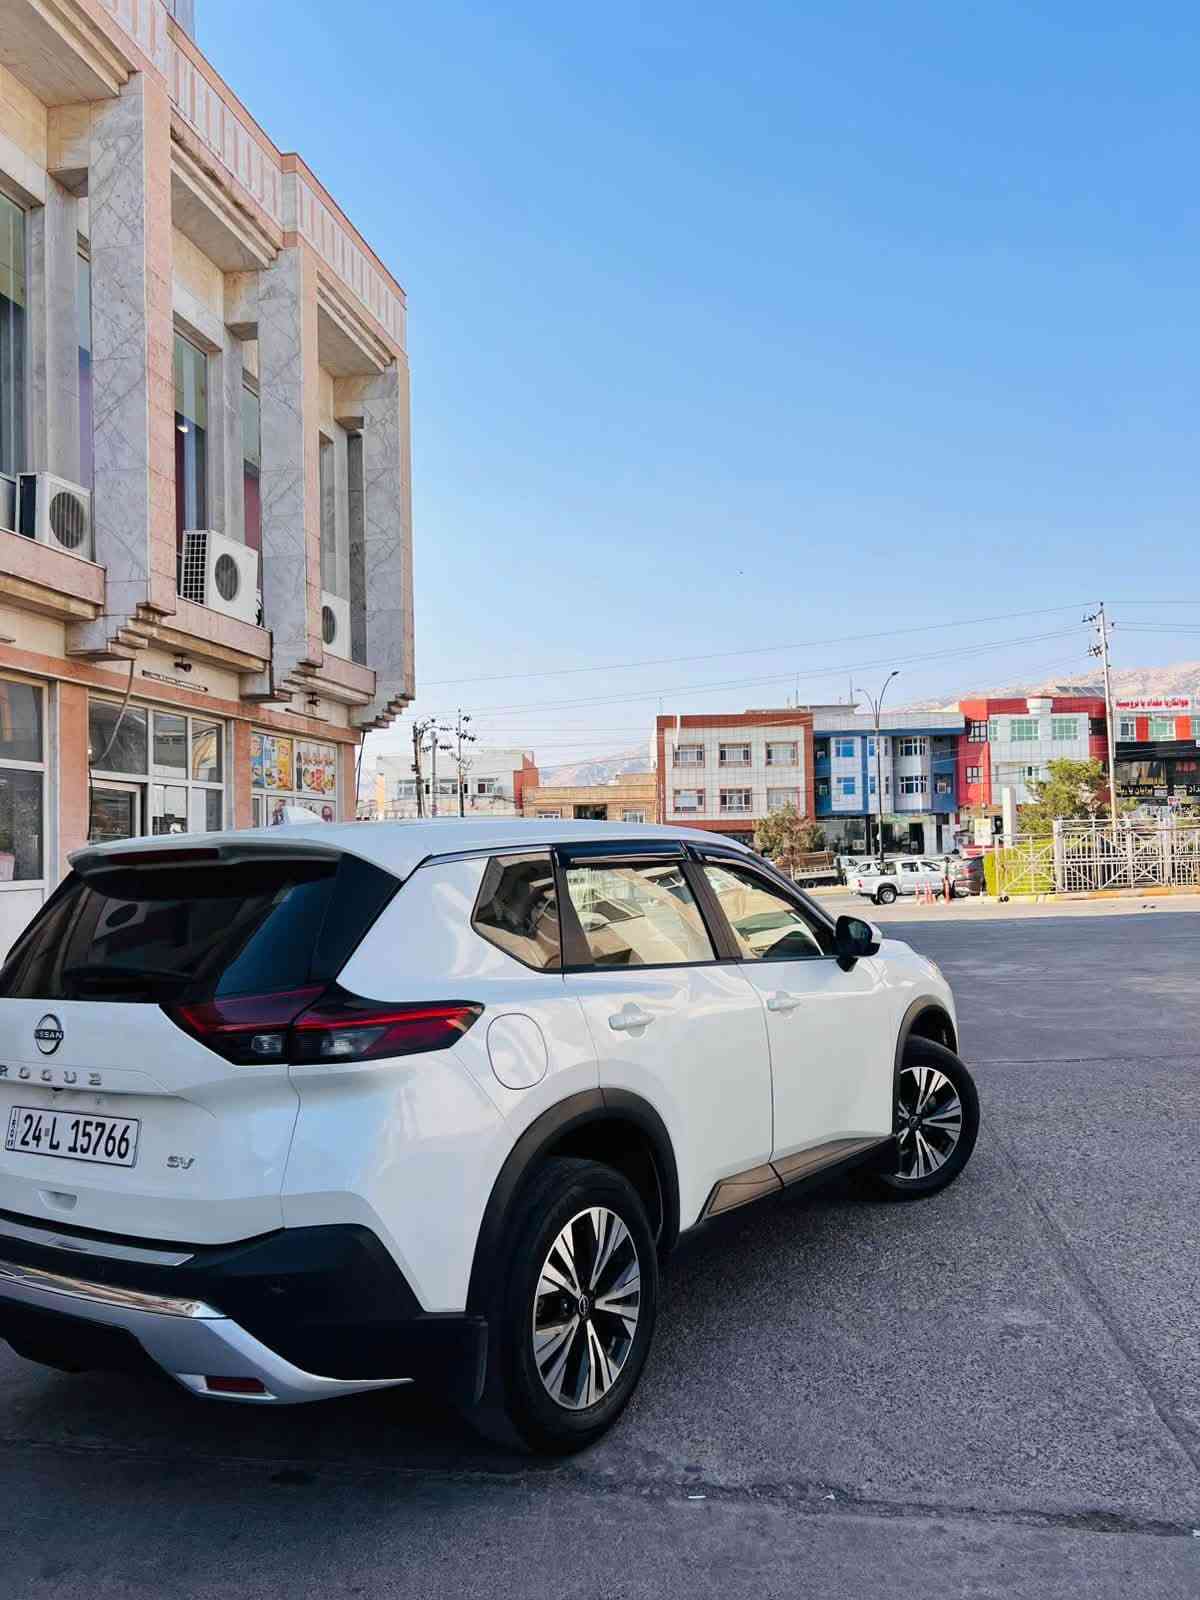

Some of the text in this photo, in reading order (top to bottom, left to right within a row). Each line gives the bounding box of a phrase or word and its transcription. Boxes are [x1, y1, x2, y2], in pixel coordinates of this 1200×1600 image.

[35, 1029, 63, 1040] SSAN
[20, 1113, 42, 1148] 24
[68, 1119, 130, 1160] 15766
[166, 1155, 195, 1170] SV
